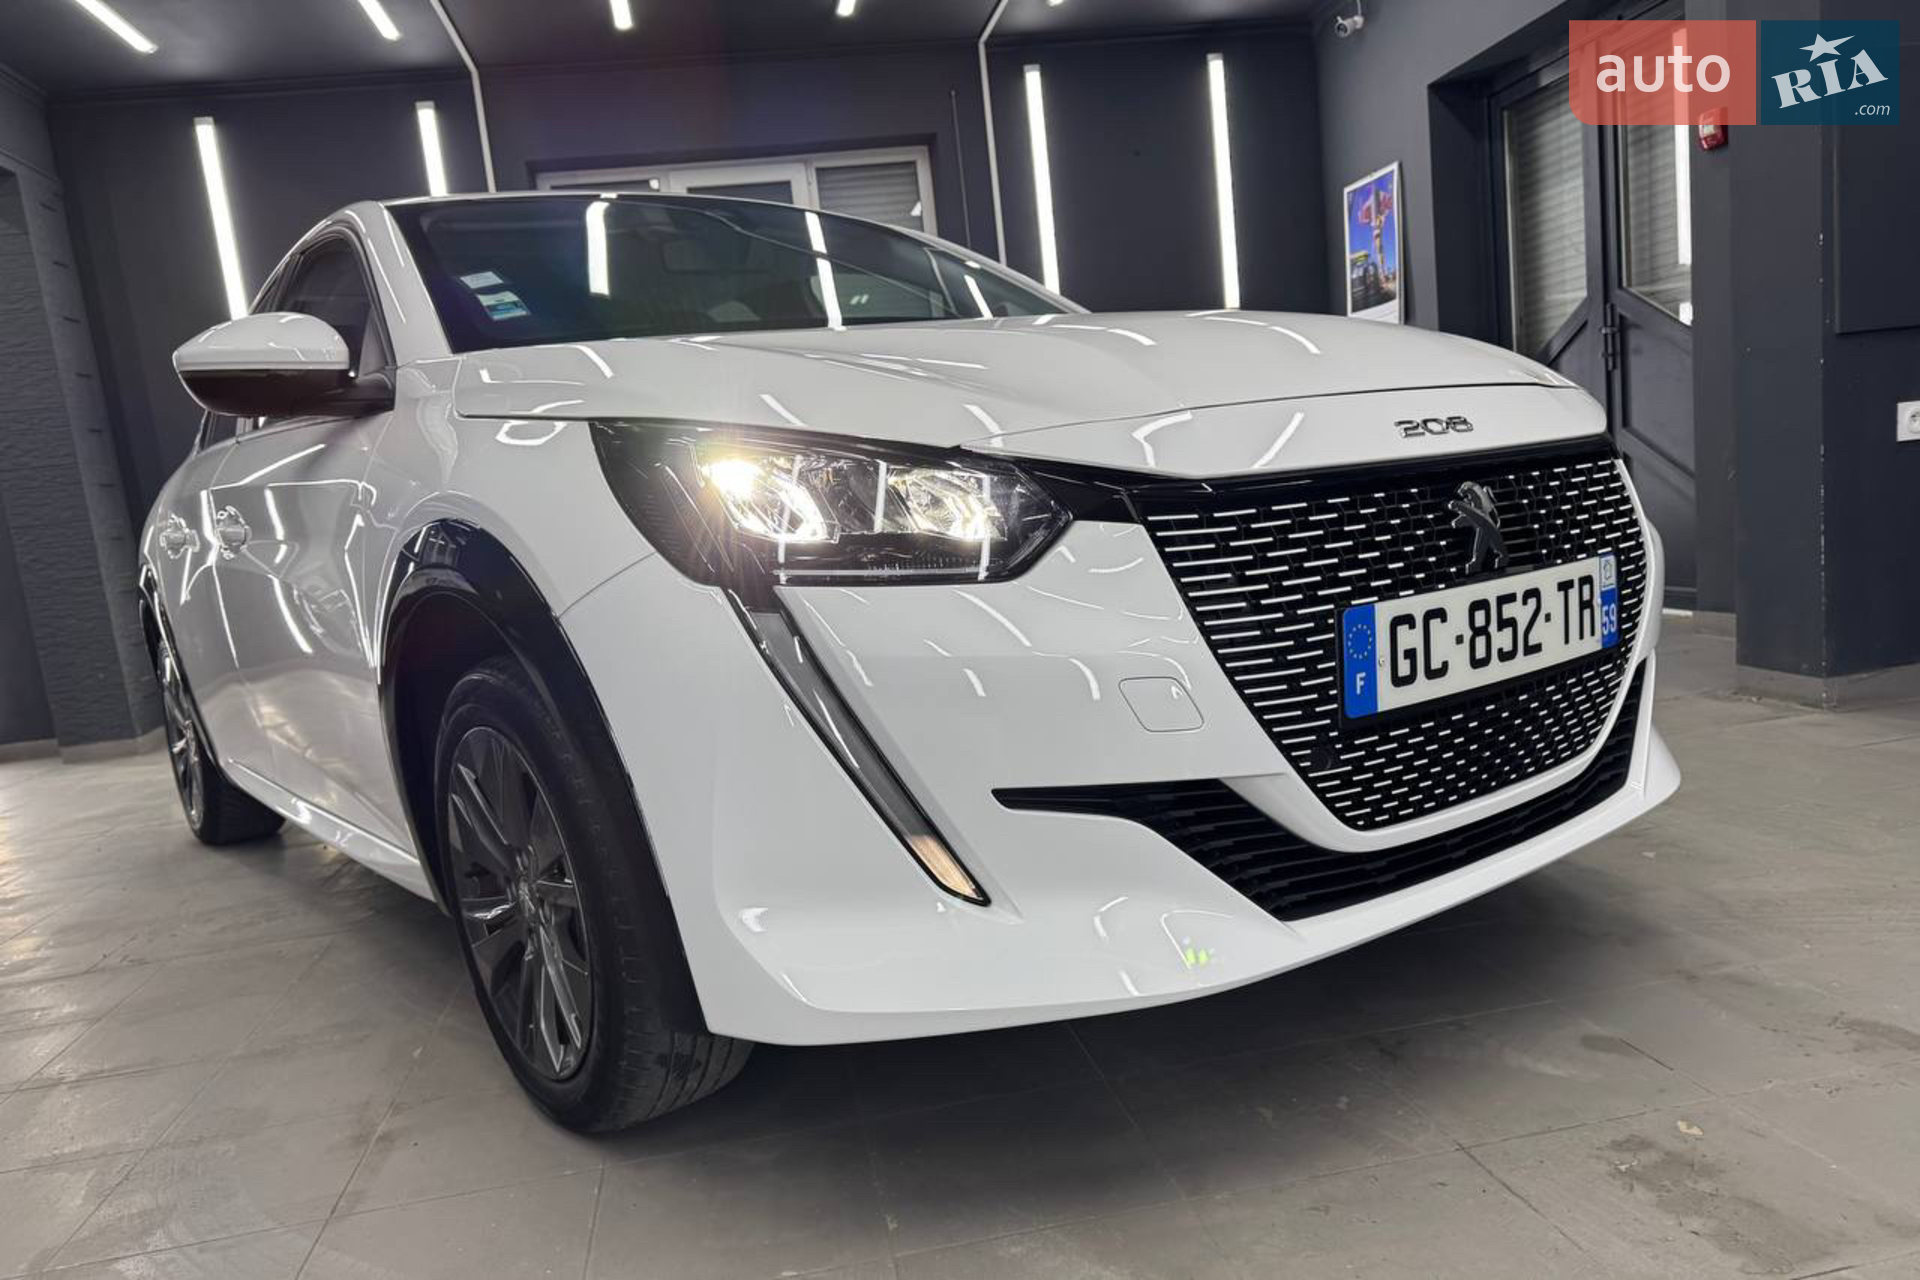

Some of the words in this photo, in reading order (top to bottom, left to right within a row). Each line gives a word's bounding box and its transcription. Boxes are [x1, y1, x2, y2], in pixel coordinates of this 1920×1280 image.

[1394, 416, 1474, 438] 208
[1355, 672, 1367, 695] F
[1602, 603, 1617, 636] 59
